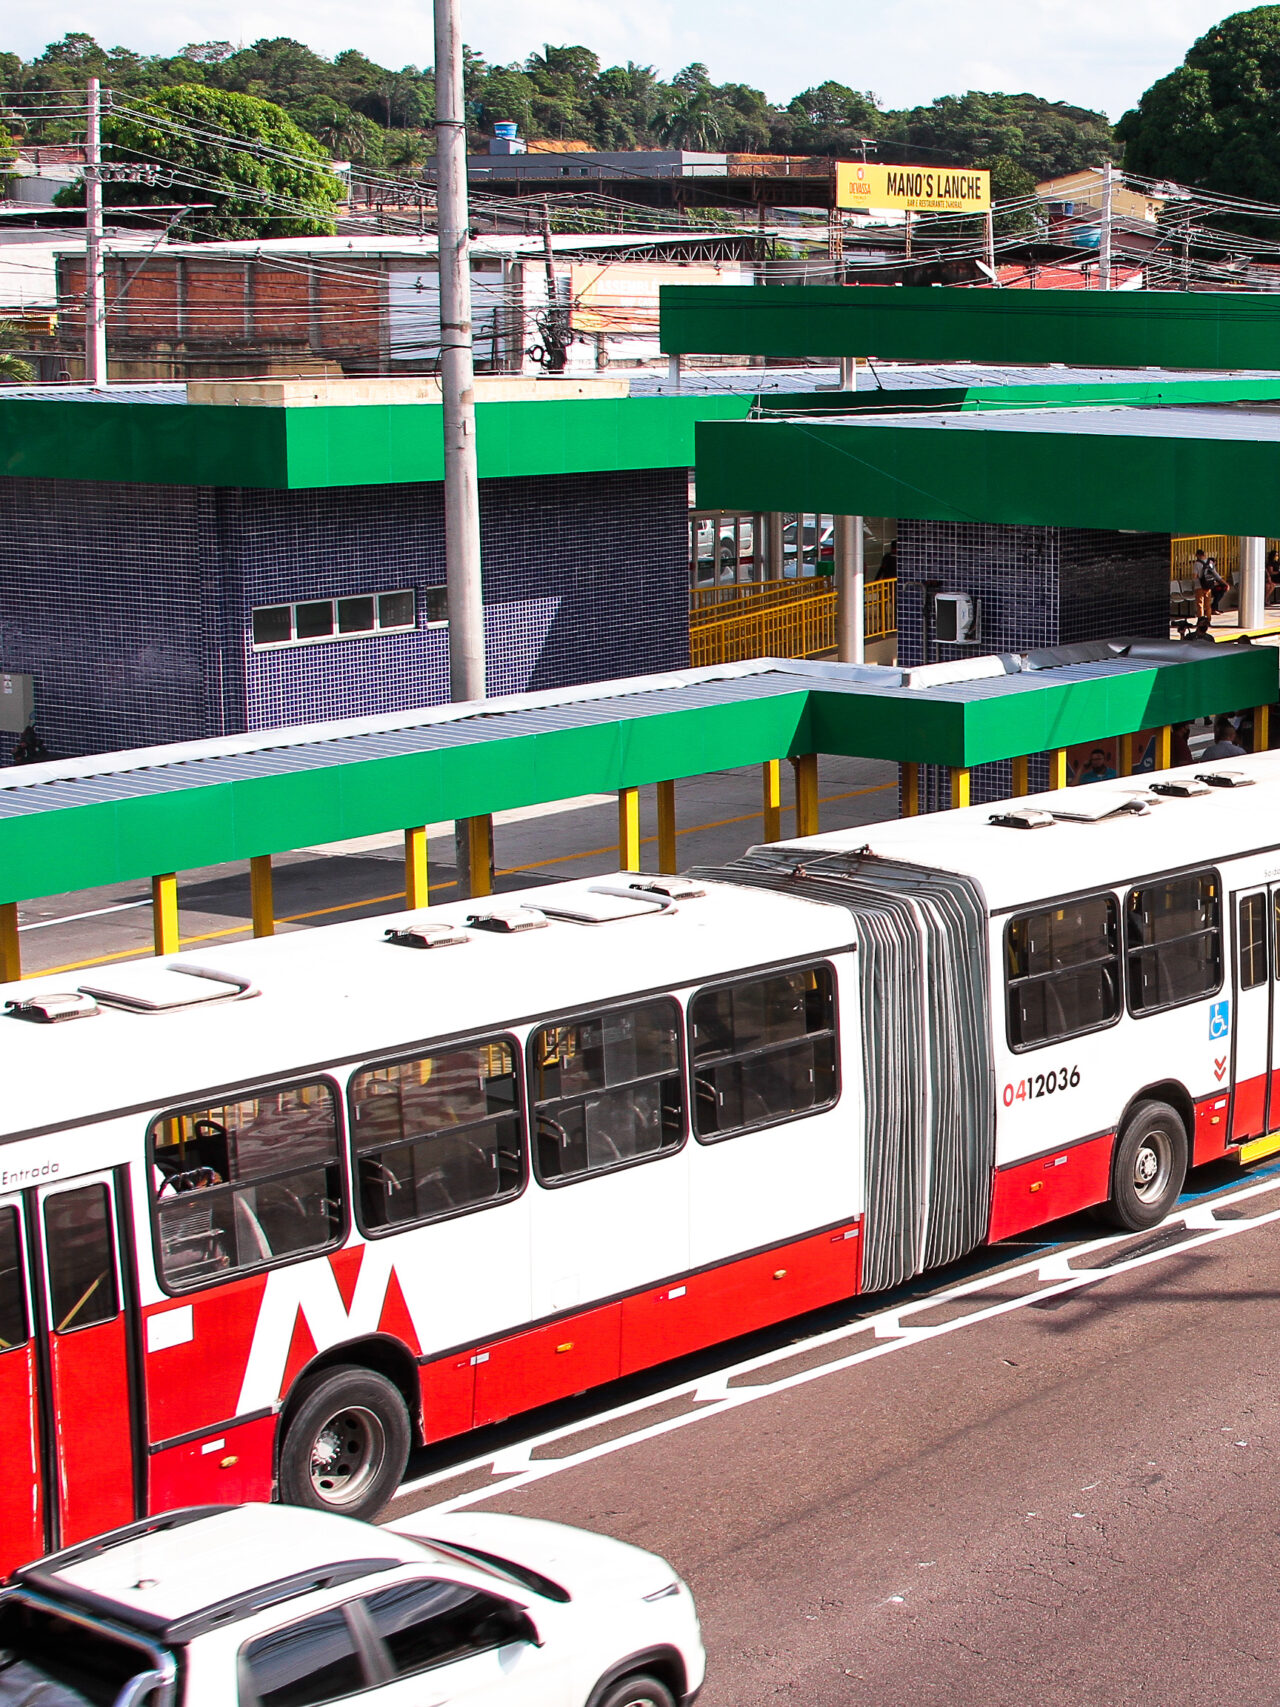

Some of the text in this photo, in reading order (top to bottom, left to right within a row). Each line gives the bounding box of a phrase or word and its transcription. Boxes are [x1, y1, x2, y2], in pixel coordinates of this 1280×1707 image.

[887, 172, 982, 200] MANO'S LANCHE
[1003, 1064, 1081, 1107] 0412036
[2, 1159, 60, 1185] Entrada
